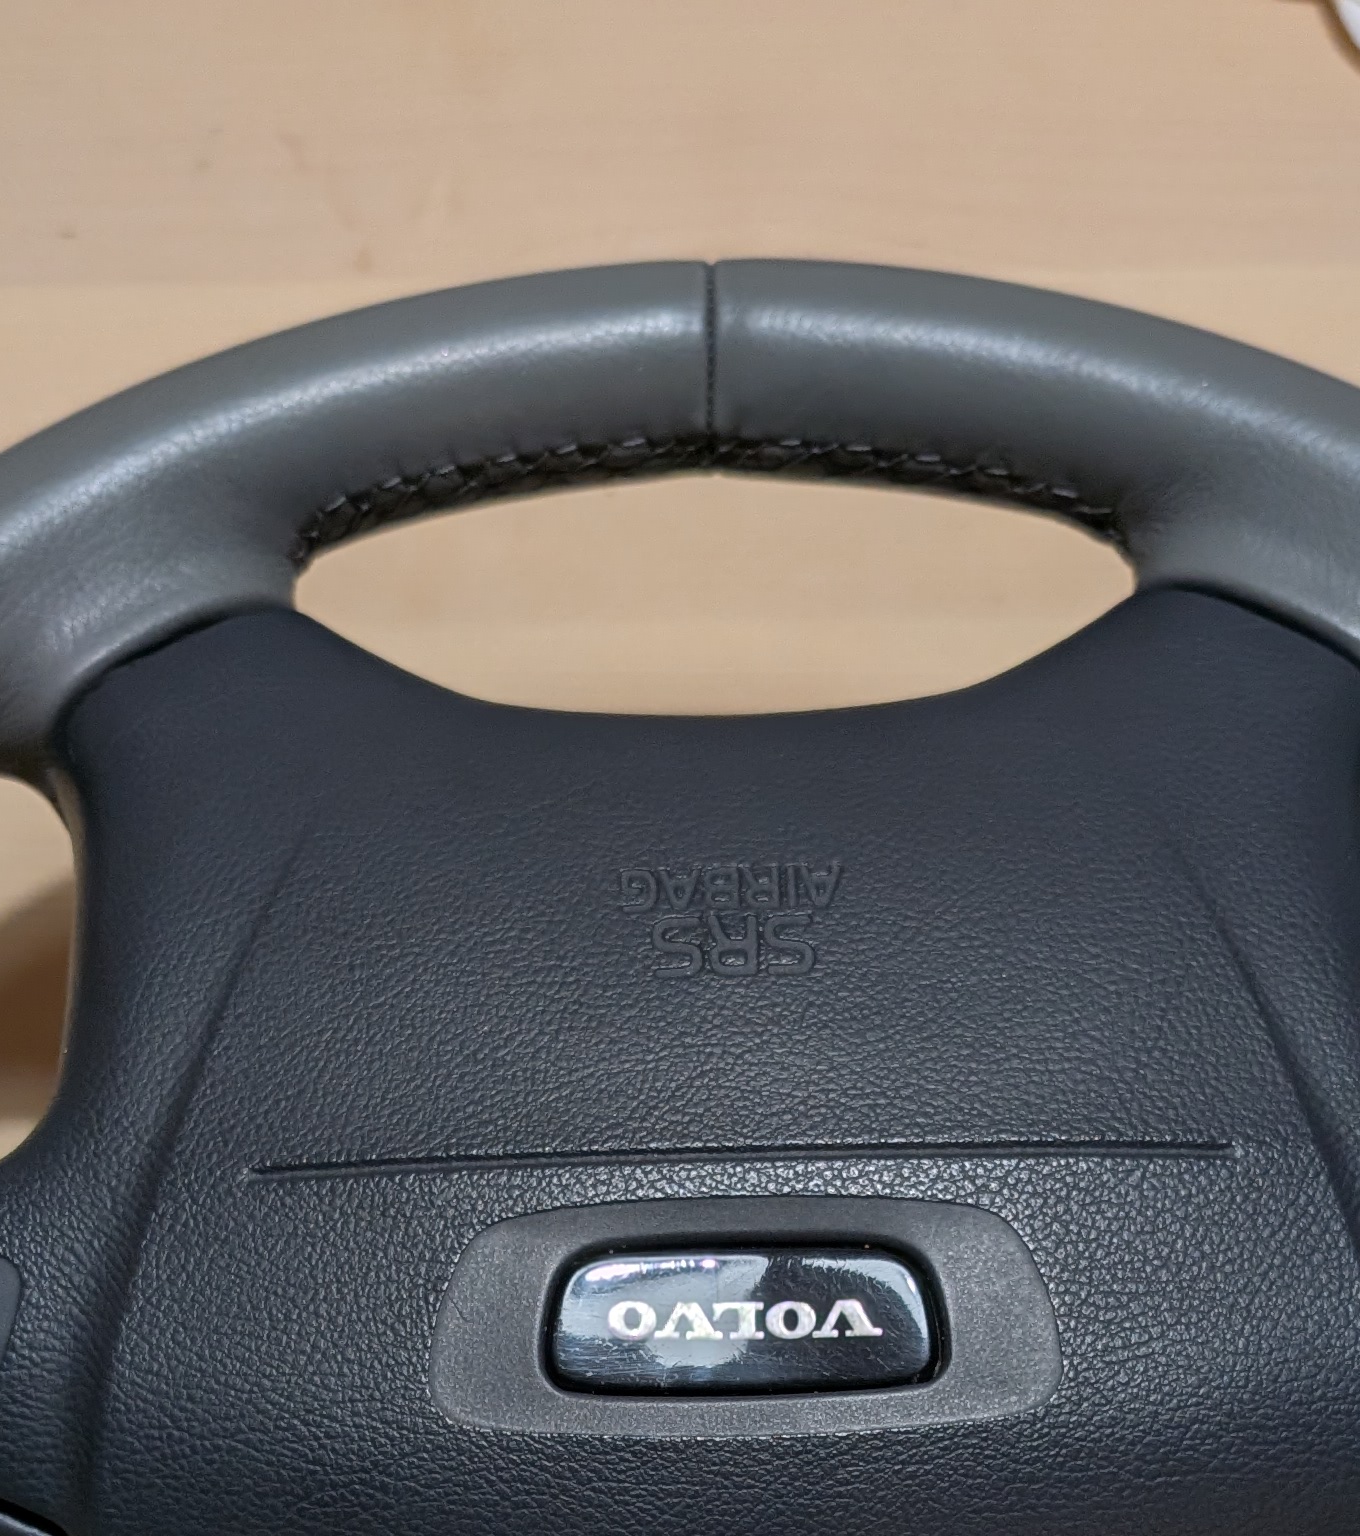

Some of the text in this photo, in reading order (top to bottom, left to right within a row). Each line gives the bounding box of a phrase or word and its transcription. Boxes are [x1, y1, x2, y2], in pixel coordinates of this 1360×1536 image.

[619, 861, 841, 912] AIRBAG
[650, 912, 816, 978] SRS
[607, 1299, 883, 1341] VOLVO
